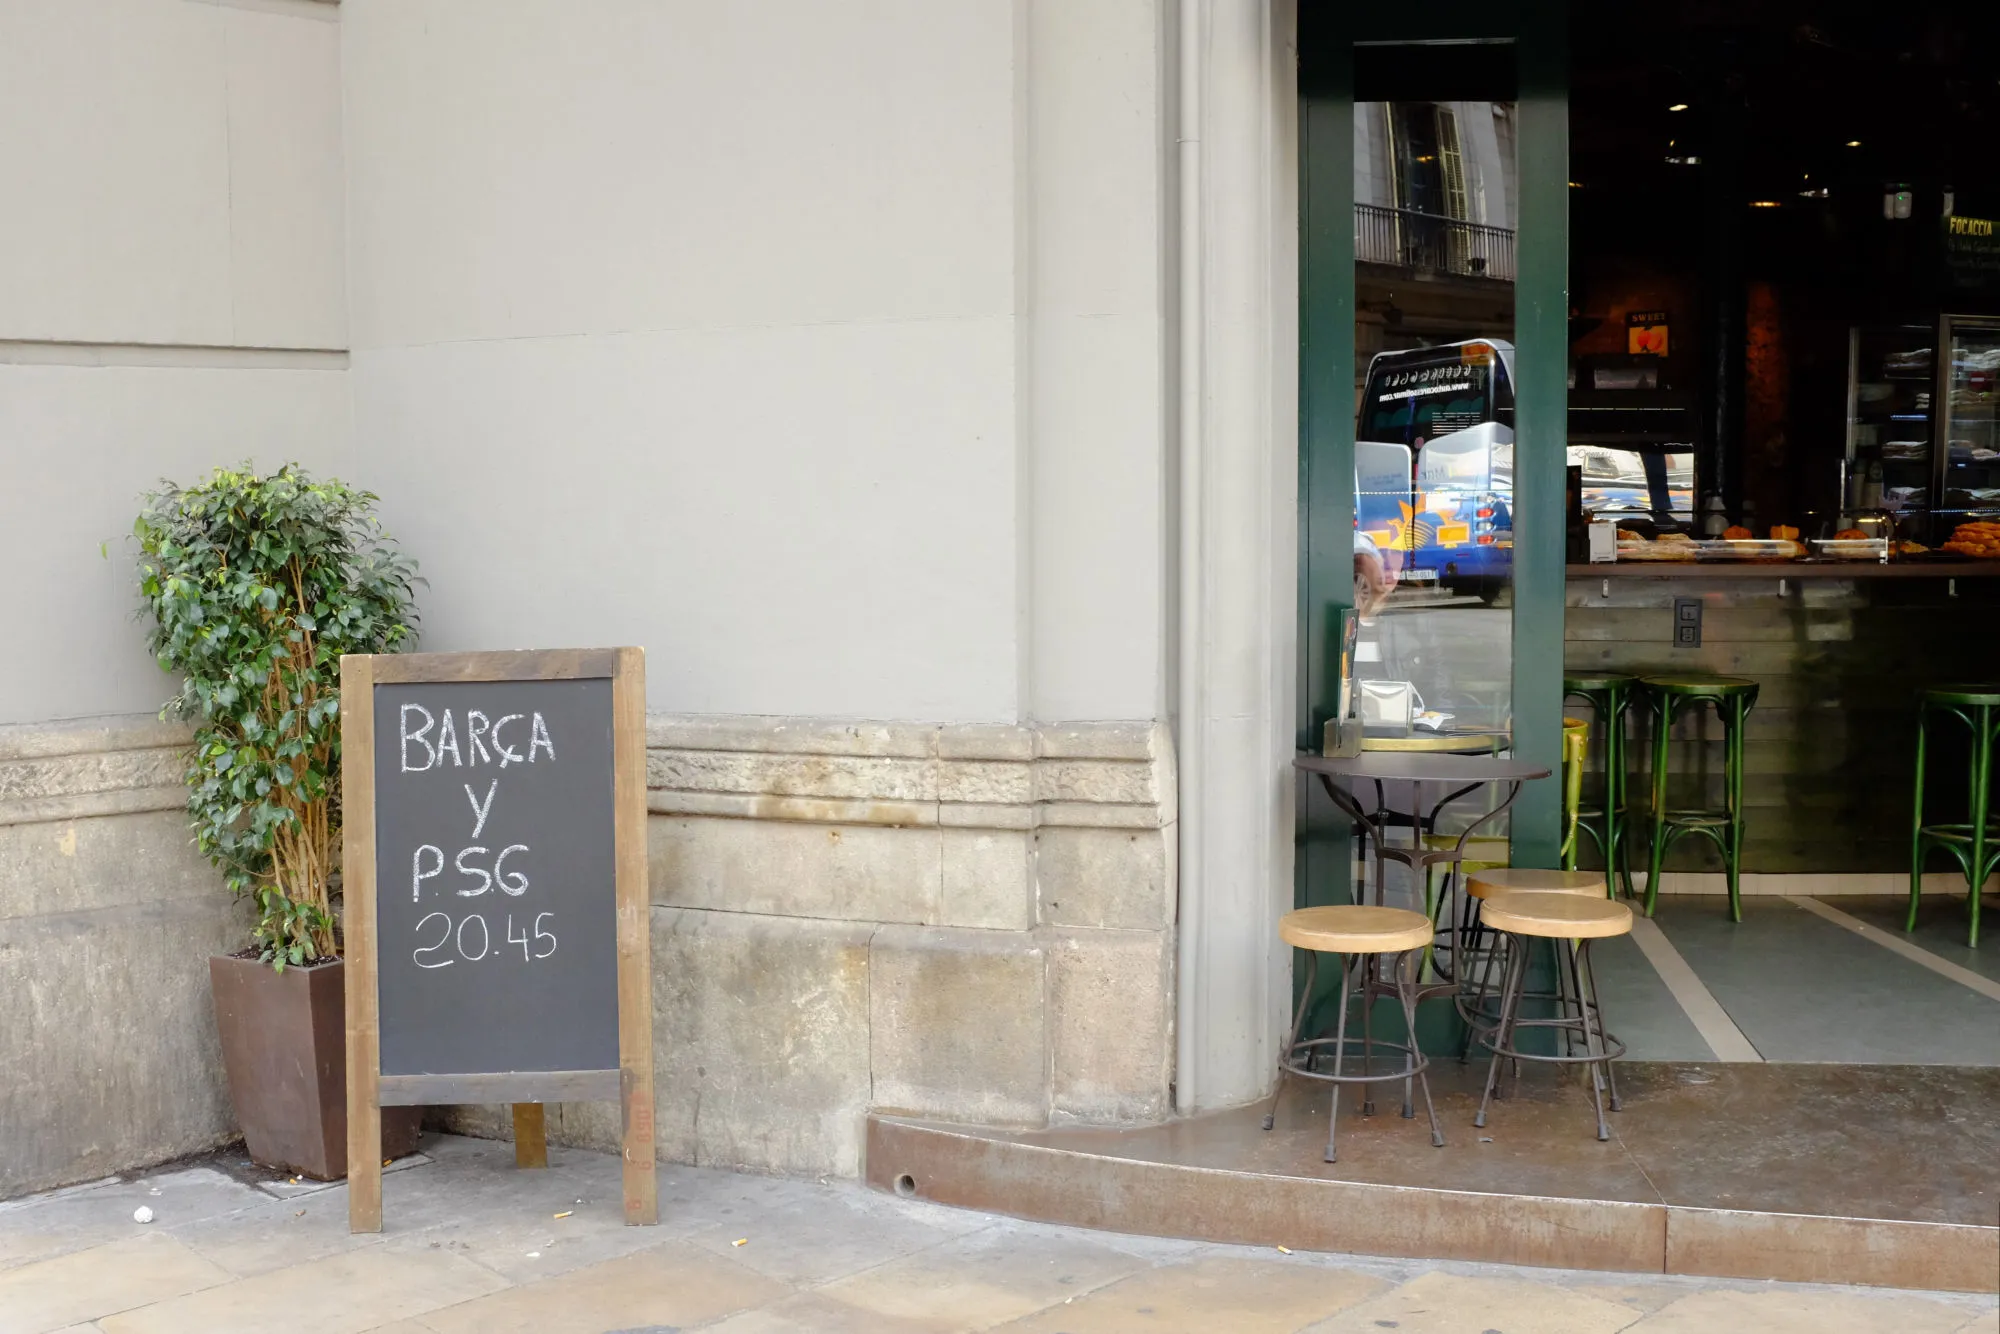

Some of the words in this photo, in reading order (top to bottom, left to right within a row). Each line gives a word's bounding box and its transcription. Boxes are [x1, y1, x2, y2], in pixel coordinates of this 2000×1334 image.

[1949, 216, 1993, 237] FOCACCIA
[399, 702, 557, 774] BARÇA
[412, 911, 558, 969] 20.45
